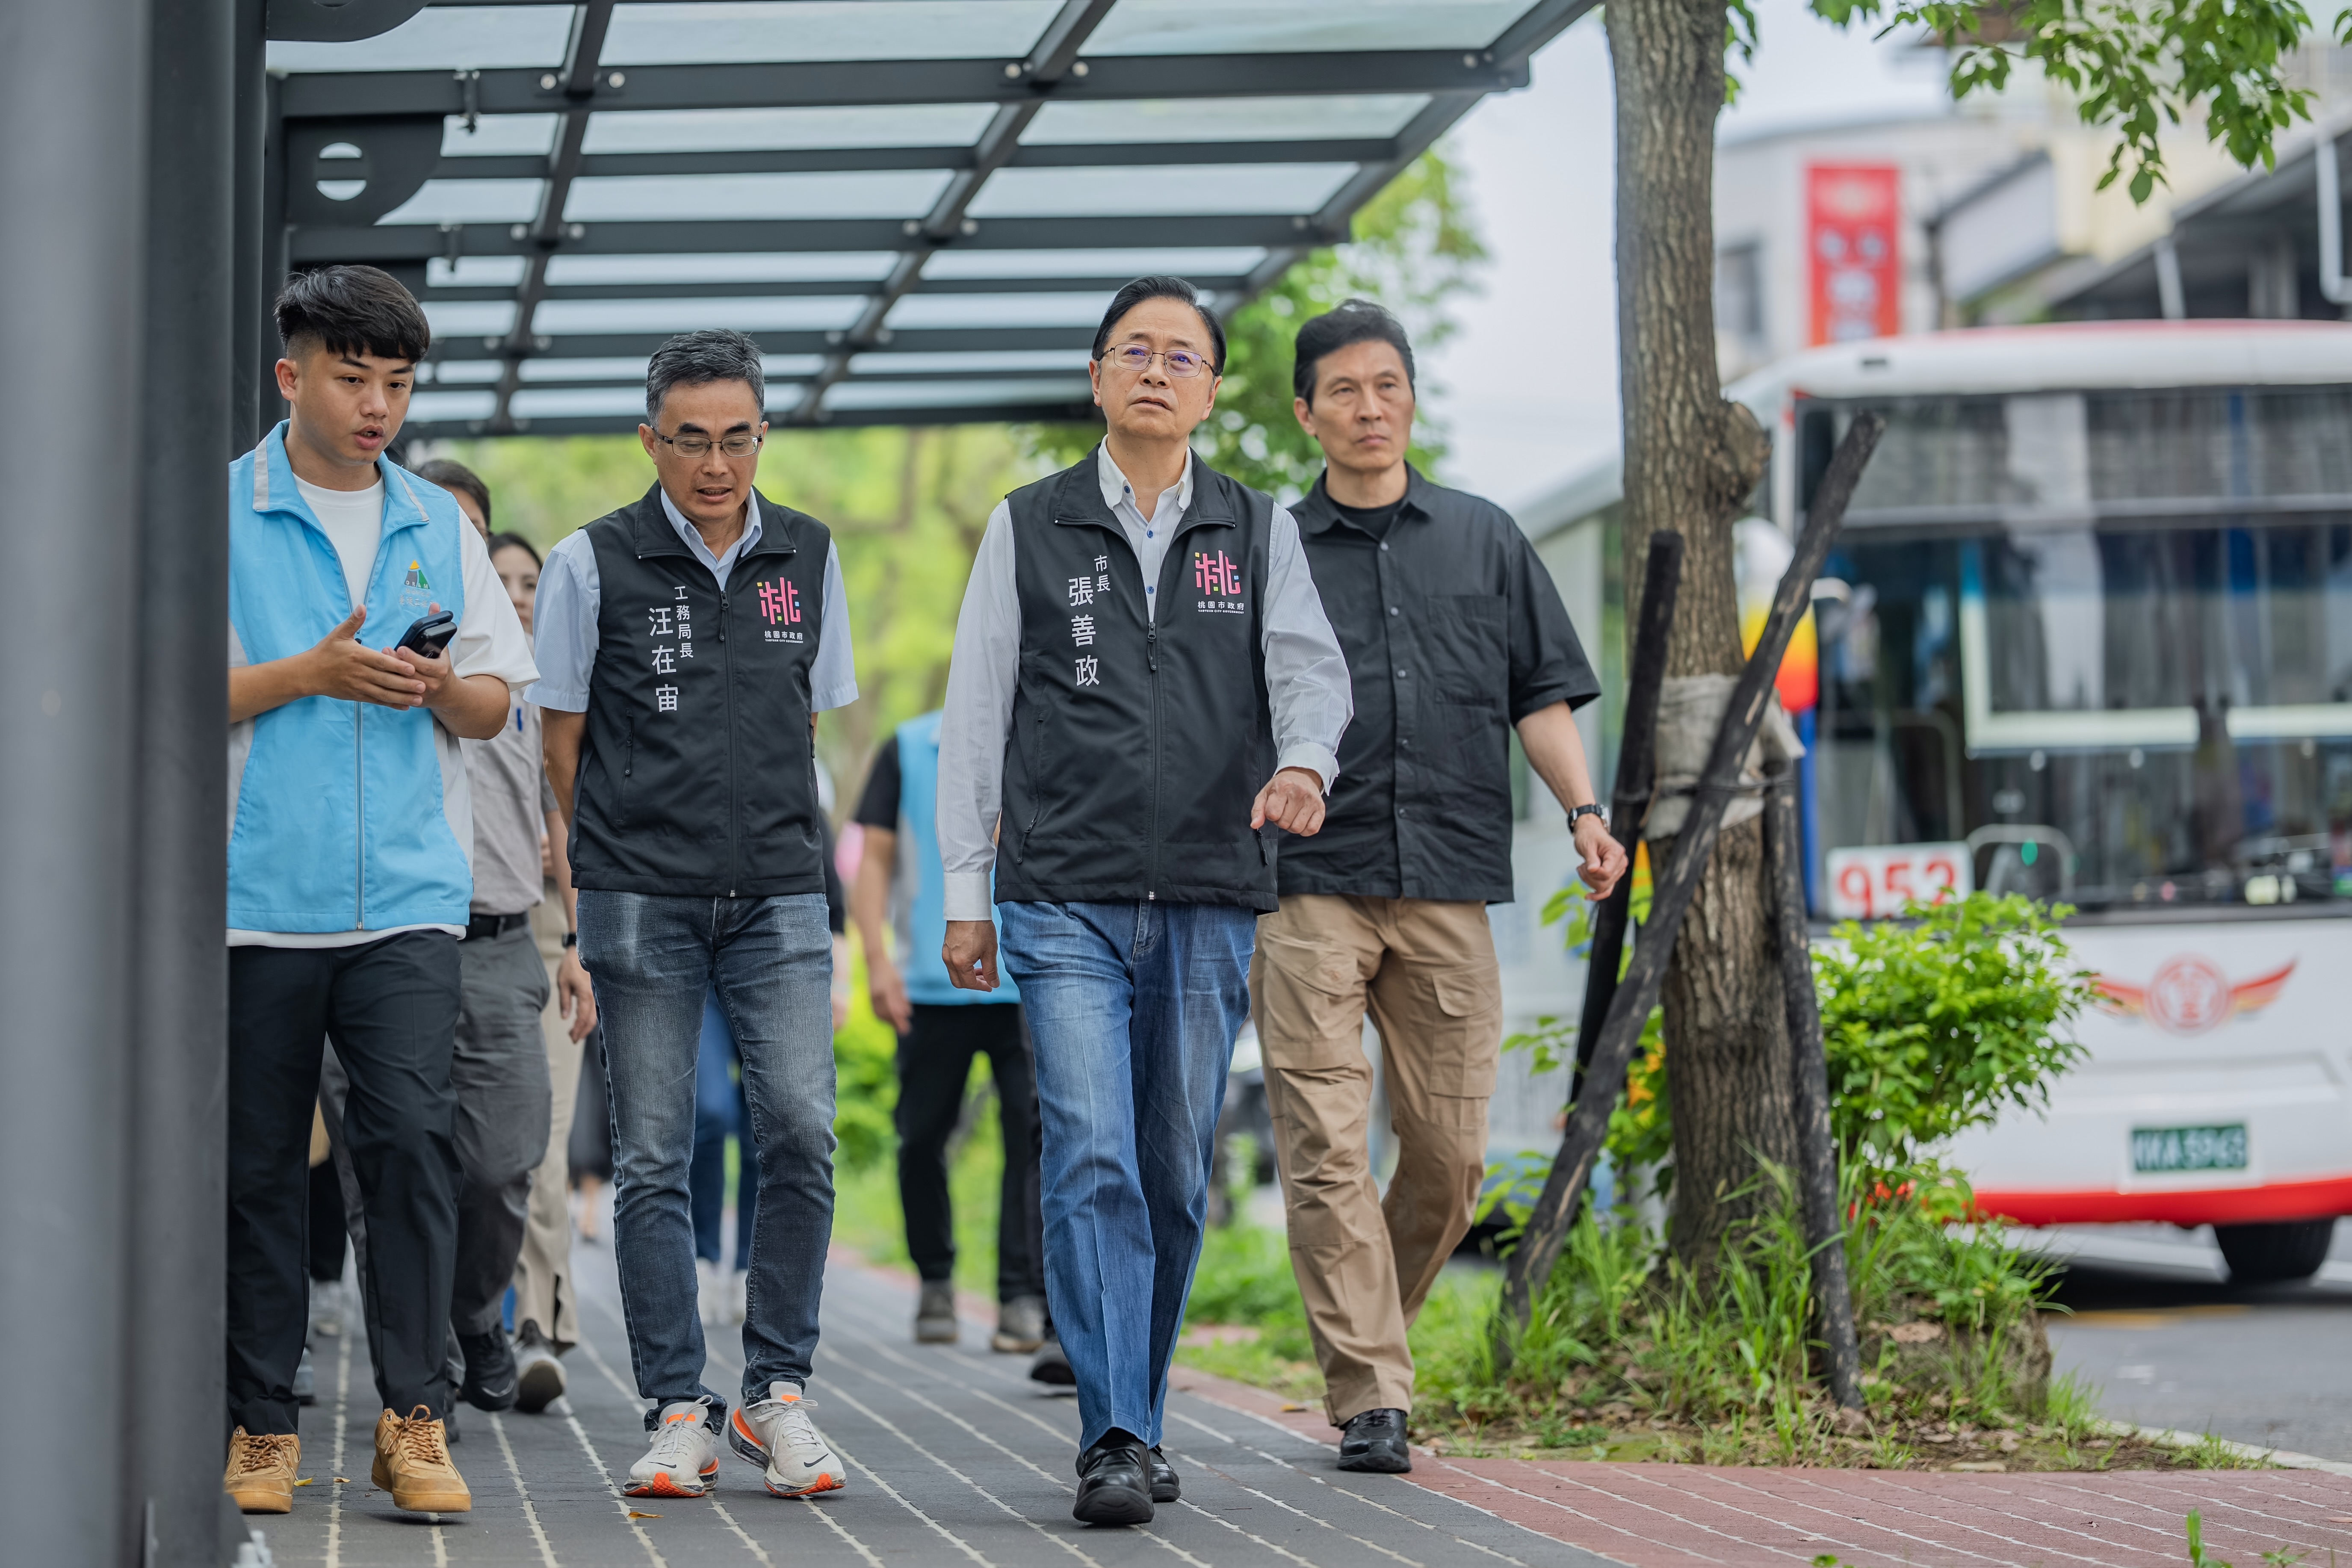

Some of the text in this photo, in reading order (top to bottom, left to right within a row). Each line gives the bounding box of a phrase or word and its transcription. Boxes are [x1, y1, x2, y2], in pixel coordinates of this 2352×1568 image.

[406, 580, 428, 589] ORAM
[1094, 555, 1111, 592] 市長
[674, 586, 694, 658] 工務局長
[1197, 601, 1244, 611] 桃園市政府
[764, 630, 803, 640] 桃園市政府
[1069, 576, 1099, 686] 張善政
[648, 607, 679, 712] 汪在宙
